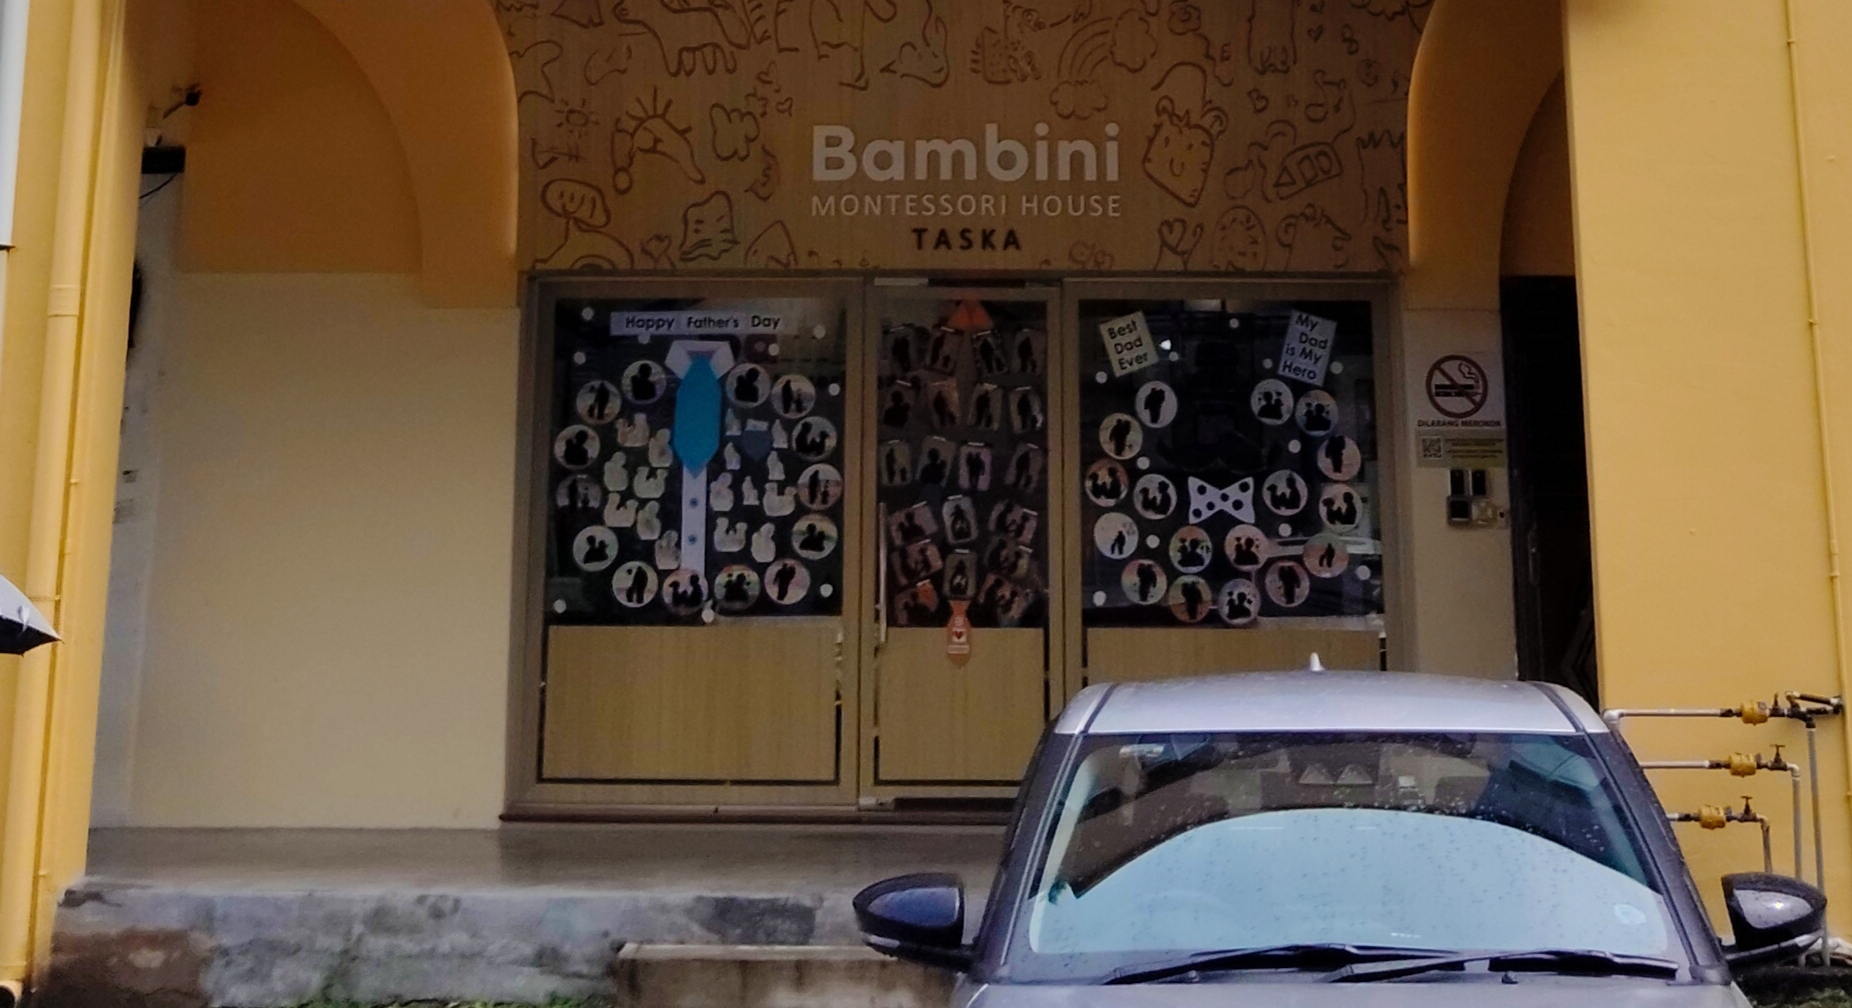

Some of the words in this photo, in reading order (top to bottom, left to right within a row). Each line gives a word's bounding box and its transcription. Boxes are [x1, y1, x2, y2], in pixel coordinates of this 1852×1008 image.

[812, 122, 1120, 181] Bambini
[811, 194, 1007, 217] MONTESSORI
[1021, 195, 1122, 217] HOUSE
[911, 227, 1022, 251] TASKA
[625, 316, 675, 331] Happy
[686, 316, 739, 329] Father's
[751, 315, 781, 330] Day
[1107, 320, 1138, 340] Best
[1295, 312, 1318, 332] My
[1114, 336, 1144, 355] Dad
[1299, 332, 1329, 351] Dad
[1118, 352, 1149, 371] Ever
[1285, 343, 1296, 357] is
[1300, 348, 1323, 366] My
[1282, 359, 1317, 381] Hero
